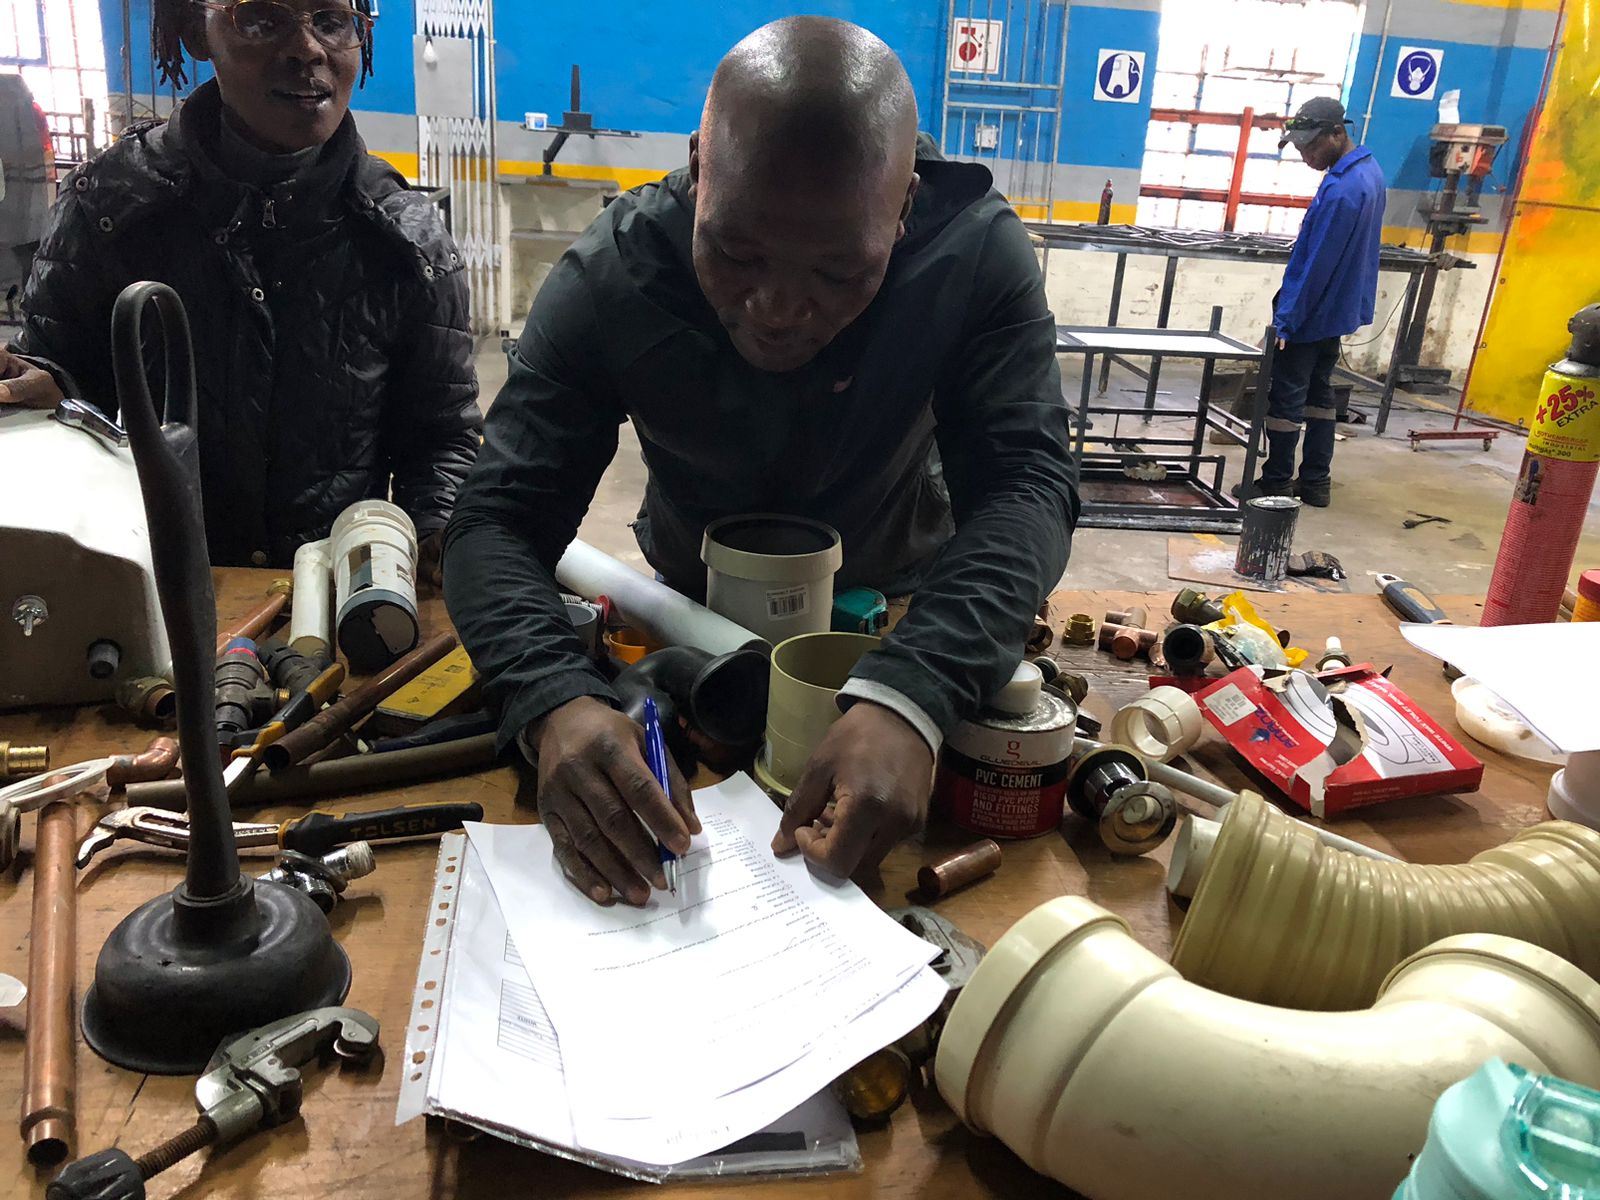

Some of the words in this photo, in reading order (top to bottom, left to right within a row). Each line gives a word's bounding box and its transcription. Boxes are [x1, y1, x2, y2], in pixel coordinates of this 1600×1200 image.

[1556, 401, 1599, 428] EXTRA
[1542, 441, 1586, 452] INDUSTRIAL
[1556, 449, 1572, 457] 300
[1401, 705, 1421, 724] TOILET
[1435, 734, 1454, 752] WHITE
[975, 768, 998, 786] PVC
[1001, 773, 1044, 788] CEMENT
[973, 790, 997, 802] RIGID
[998, 795, 1015, 804] PVC
[1017, 795, 1040, 804] PIPES
[972, 799, 993, 811] AND
[995, 803, 1039, 814] FITTINGS
[350, 817, 437, 840] TOLSEN
